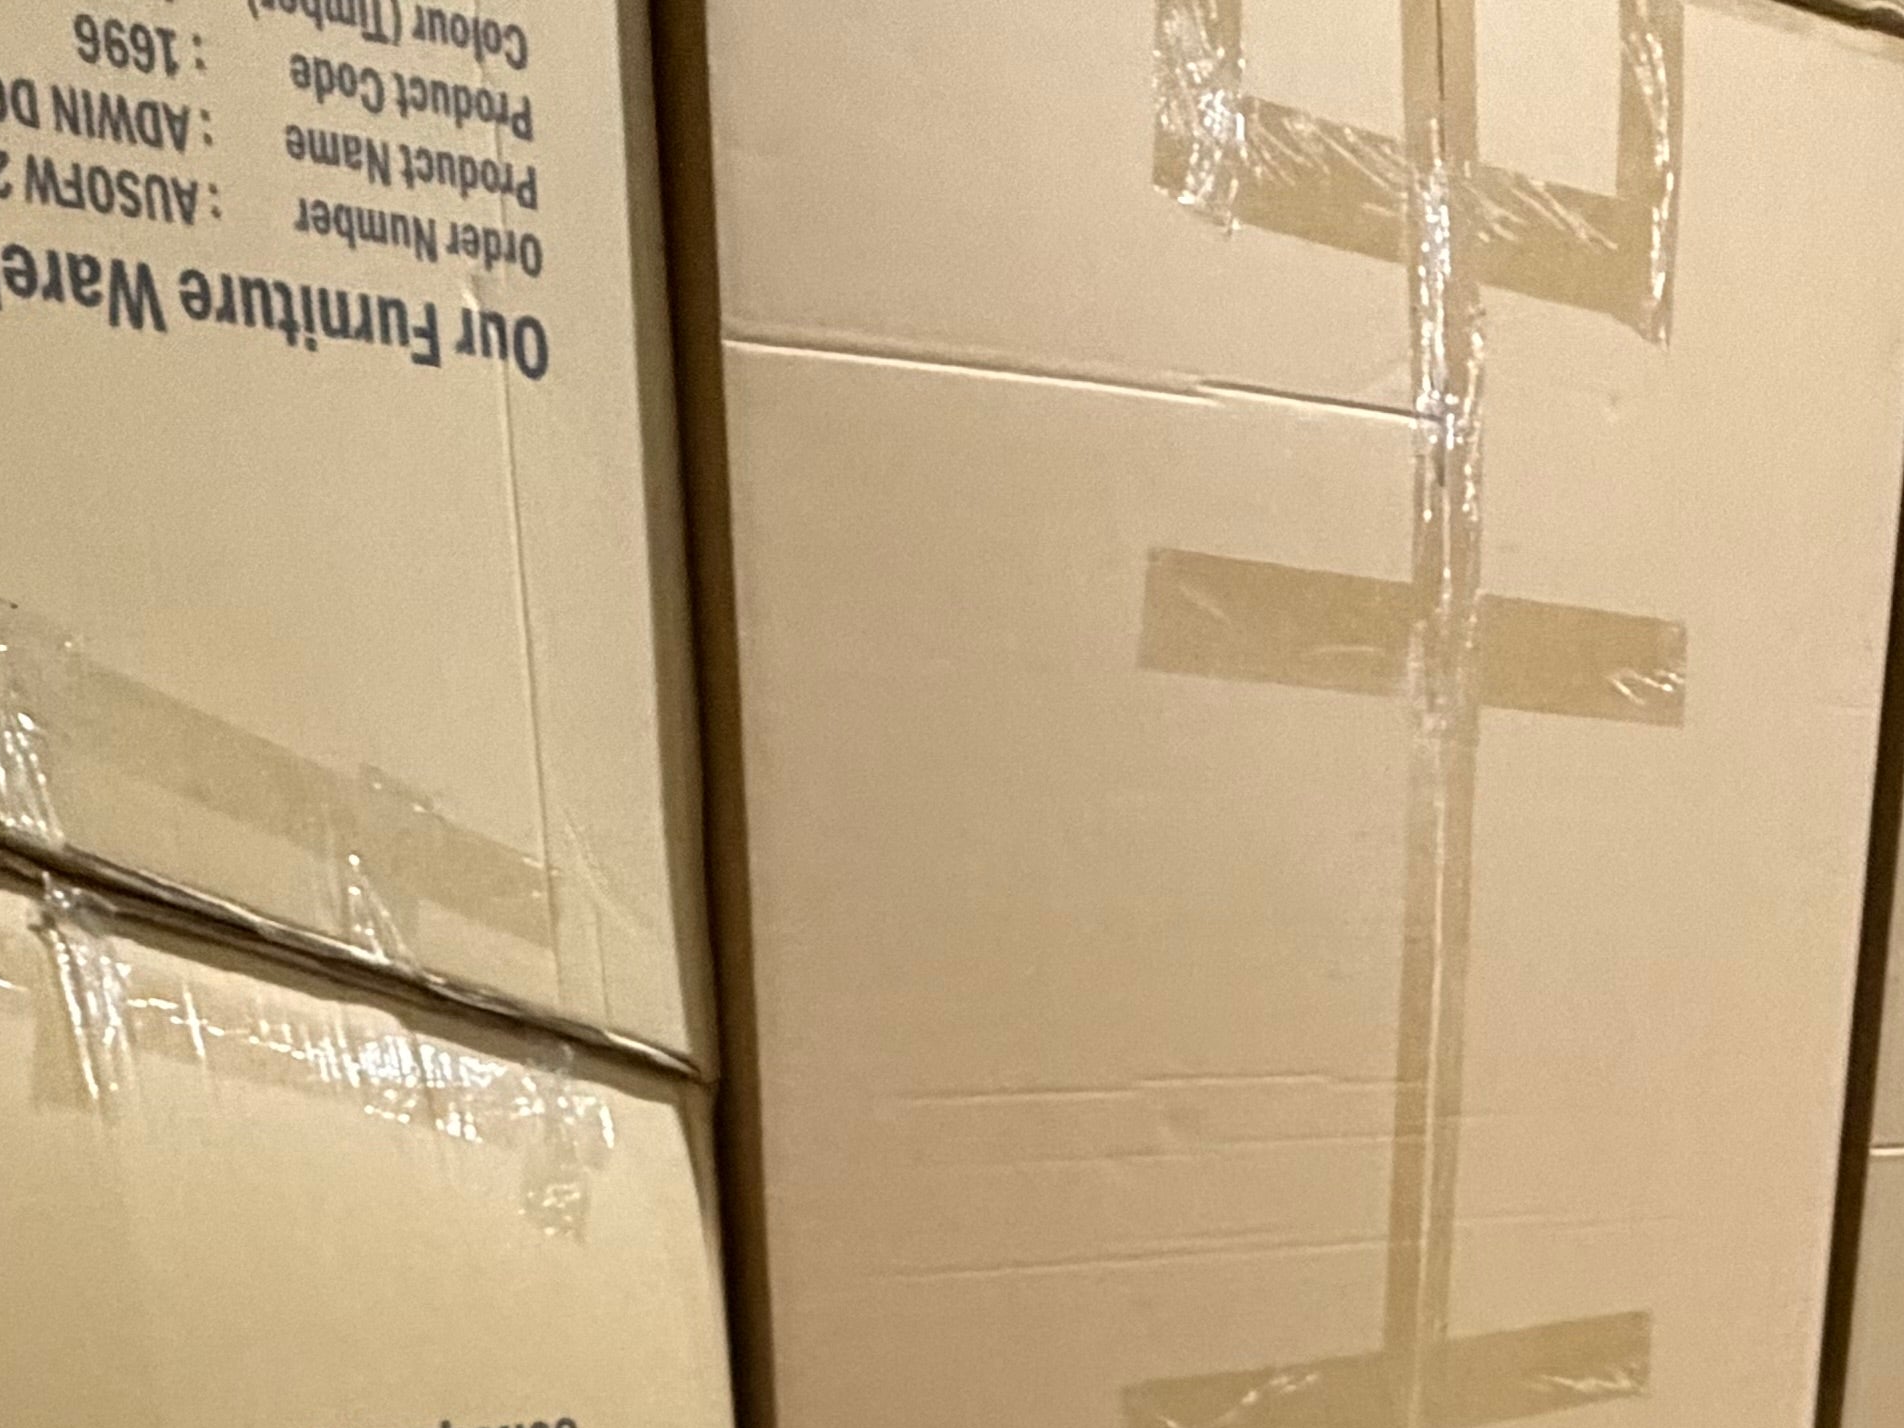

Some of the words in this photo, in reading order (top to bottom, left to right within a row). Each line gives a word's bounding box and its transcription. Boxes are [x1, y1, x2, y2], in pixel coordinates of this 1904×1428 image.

[73, 13, 180, 78] 1696
[411, 3, 529, 71] Colour
[52, 83, 192, 153] ADWIN
[289, 53, 386, 115] Code
[395, 71, 533, 142] Product
[25, 153, 199, 226] AUSOFW
[285, 124, 392, 187] Name
[399, 142, 538, 210] Product
[295, 197, 439, 263] Number
[445, 221, 543, 278] Order
[177, 267, 443, 368] Furniture
[453, 306, 550, 381] Our
